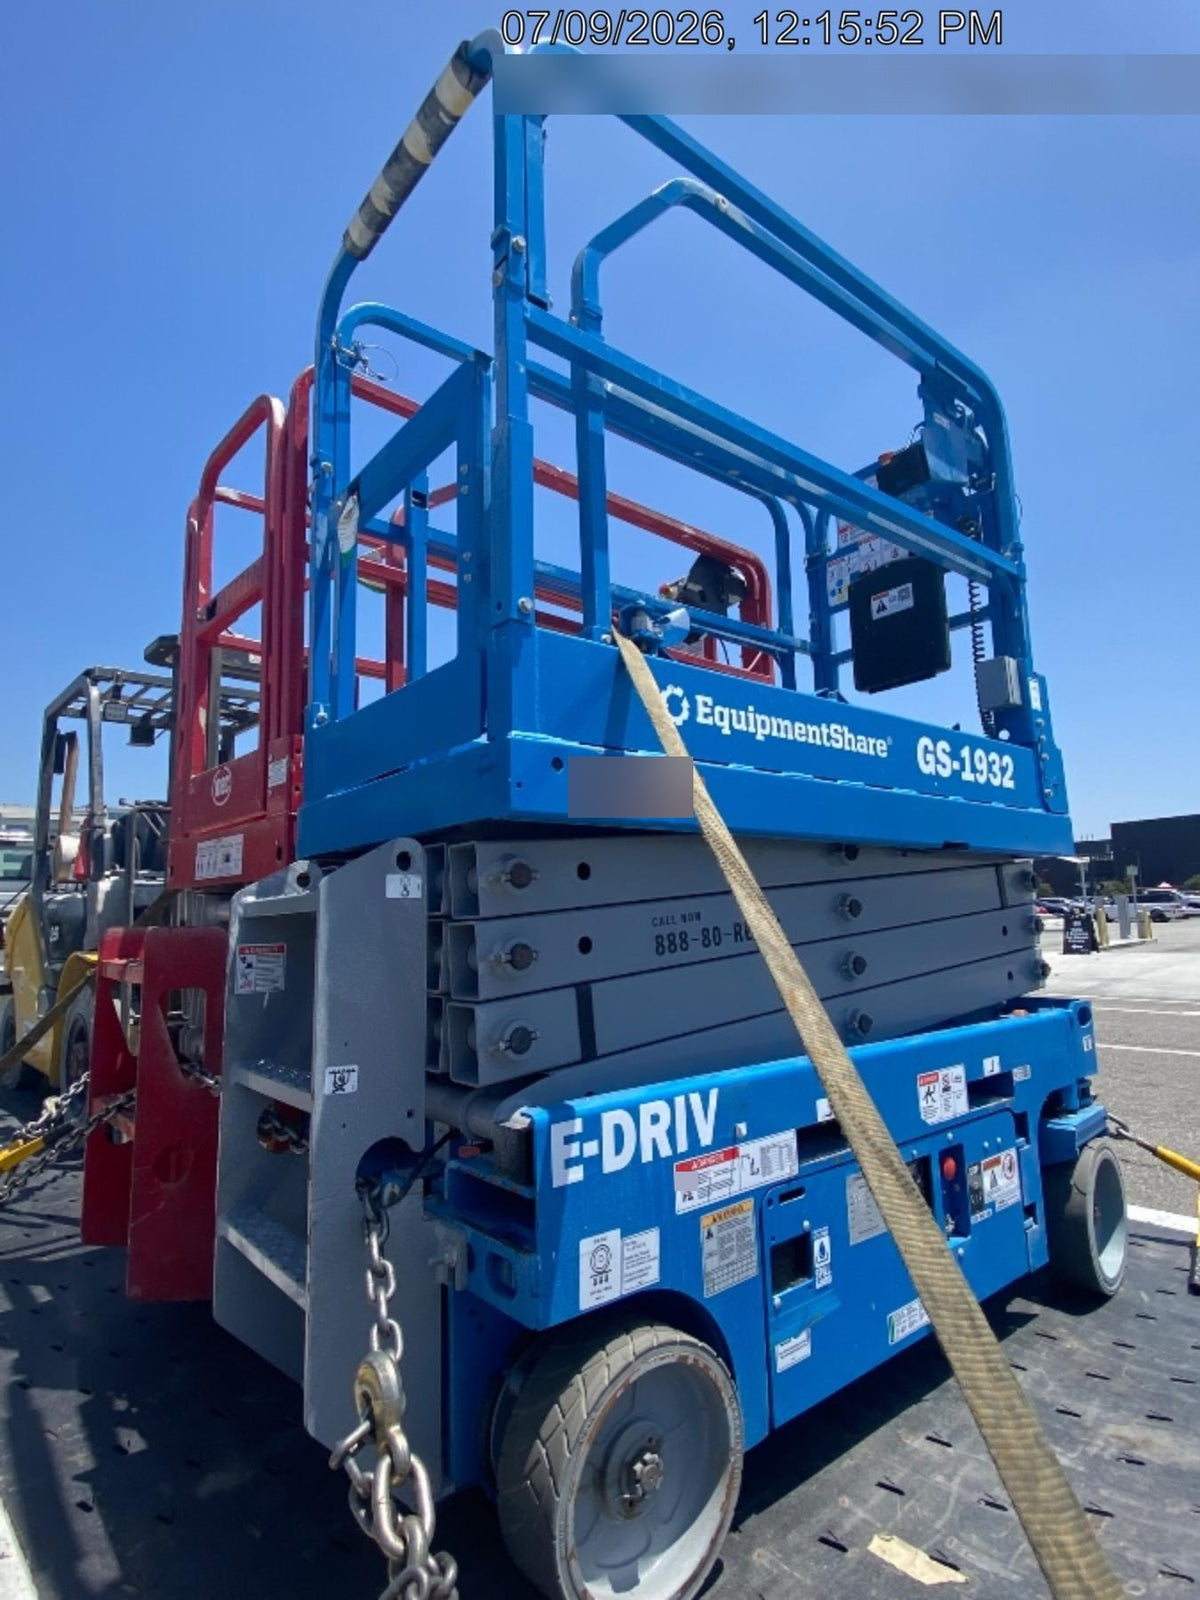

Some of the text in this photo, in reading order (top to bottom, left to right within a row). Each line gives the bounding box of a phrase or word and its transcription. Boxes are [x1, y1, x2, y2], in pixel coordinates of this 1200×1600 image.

[695, 694, 889, 758] EquipmentShare
[917, 736, 1015, 789] GS-1932
[652, 916, 676, 928] CALL
[551, 1088, 719, 1189] E-DRIV
